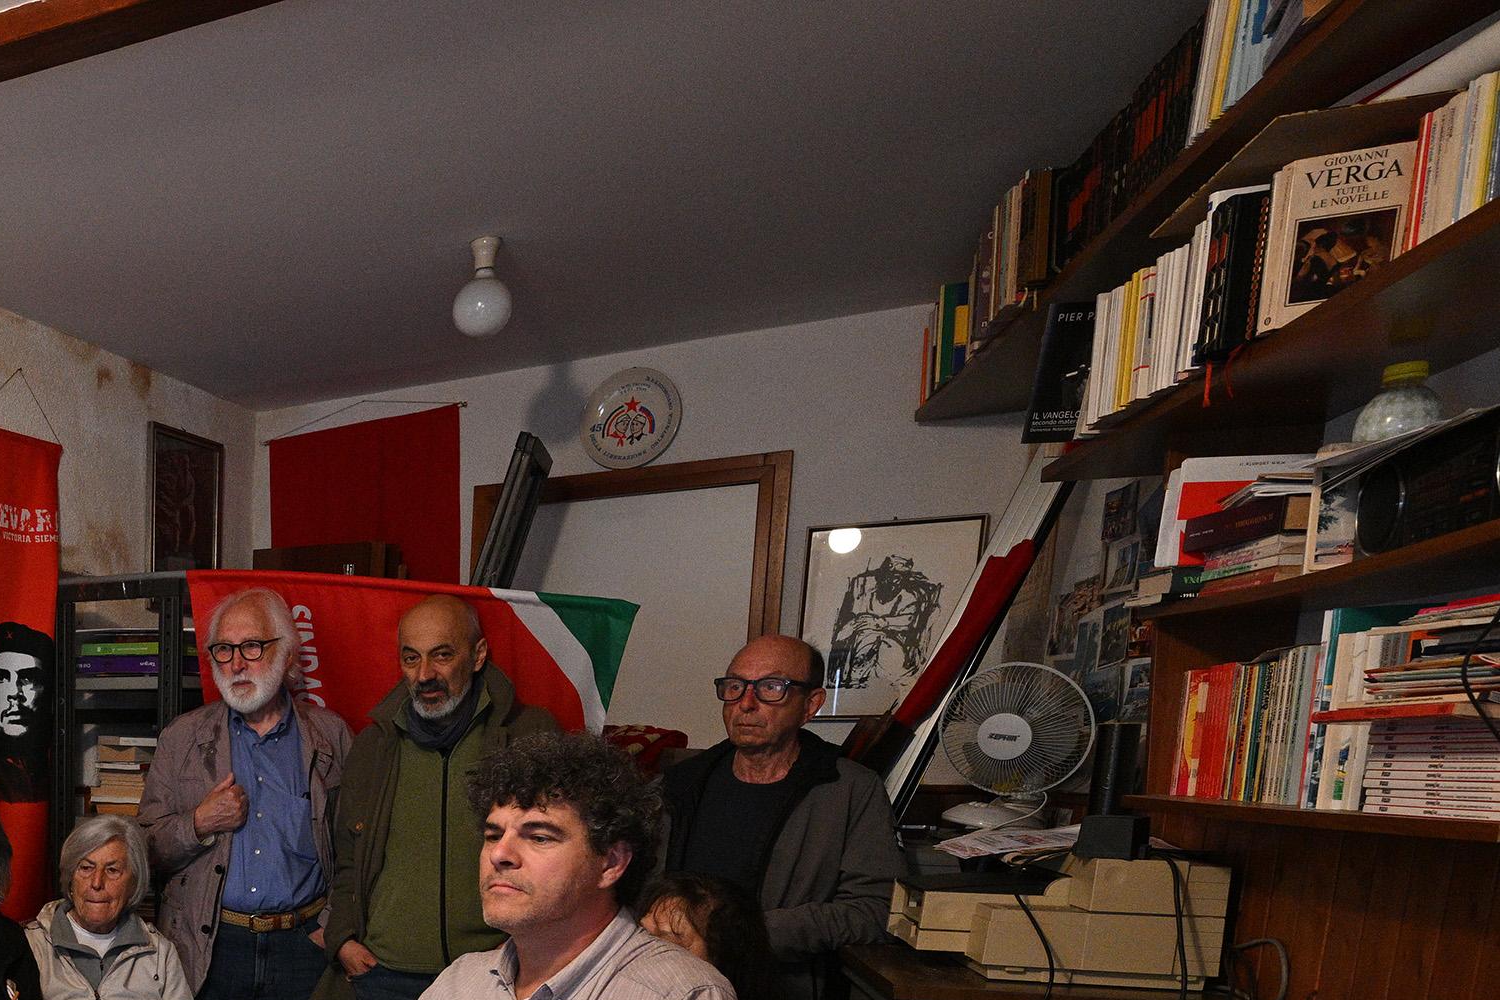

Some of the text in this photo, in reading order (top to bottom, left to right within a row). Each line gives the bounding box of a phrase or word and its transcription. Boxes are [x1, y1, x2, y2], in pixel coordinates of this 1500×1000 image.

[1324, 149, 1389, 167] GIOVANNI
[1305, 159, 1404, 189] VERGA
[1336, 184, 1369, 196] TUTTE
[1312, 190, 1389, 209] LE NOVELLE
[1057, 312, 1083, 322] PIER
[1032, 411, 1039, 420] IL
[3, 531, 32, 543] VICTORIA
